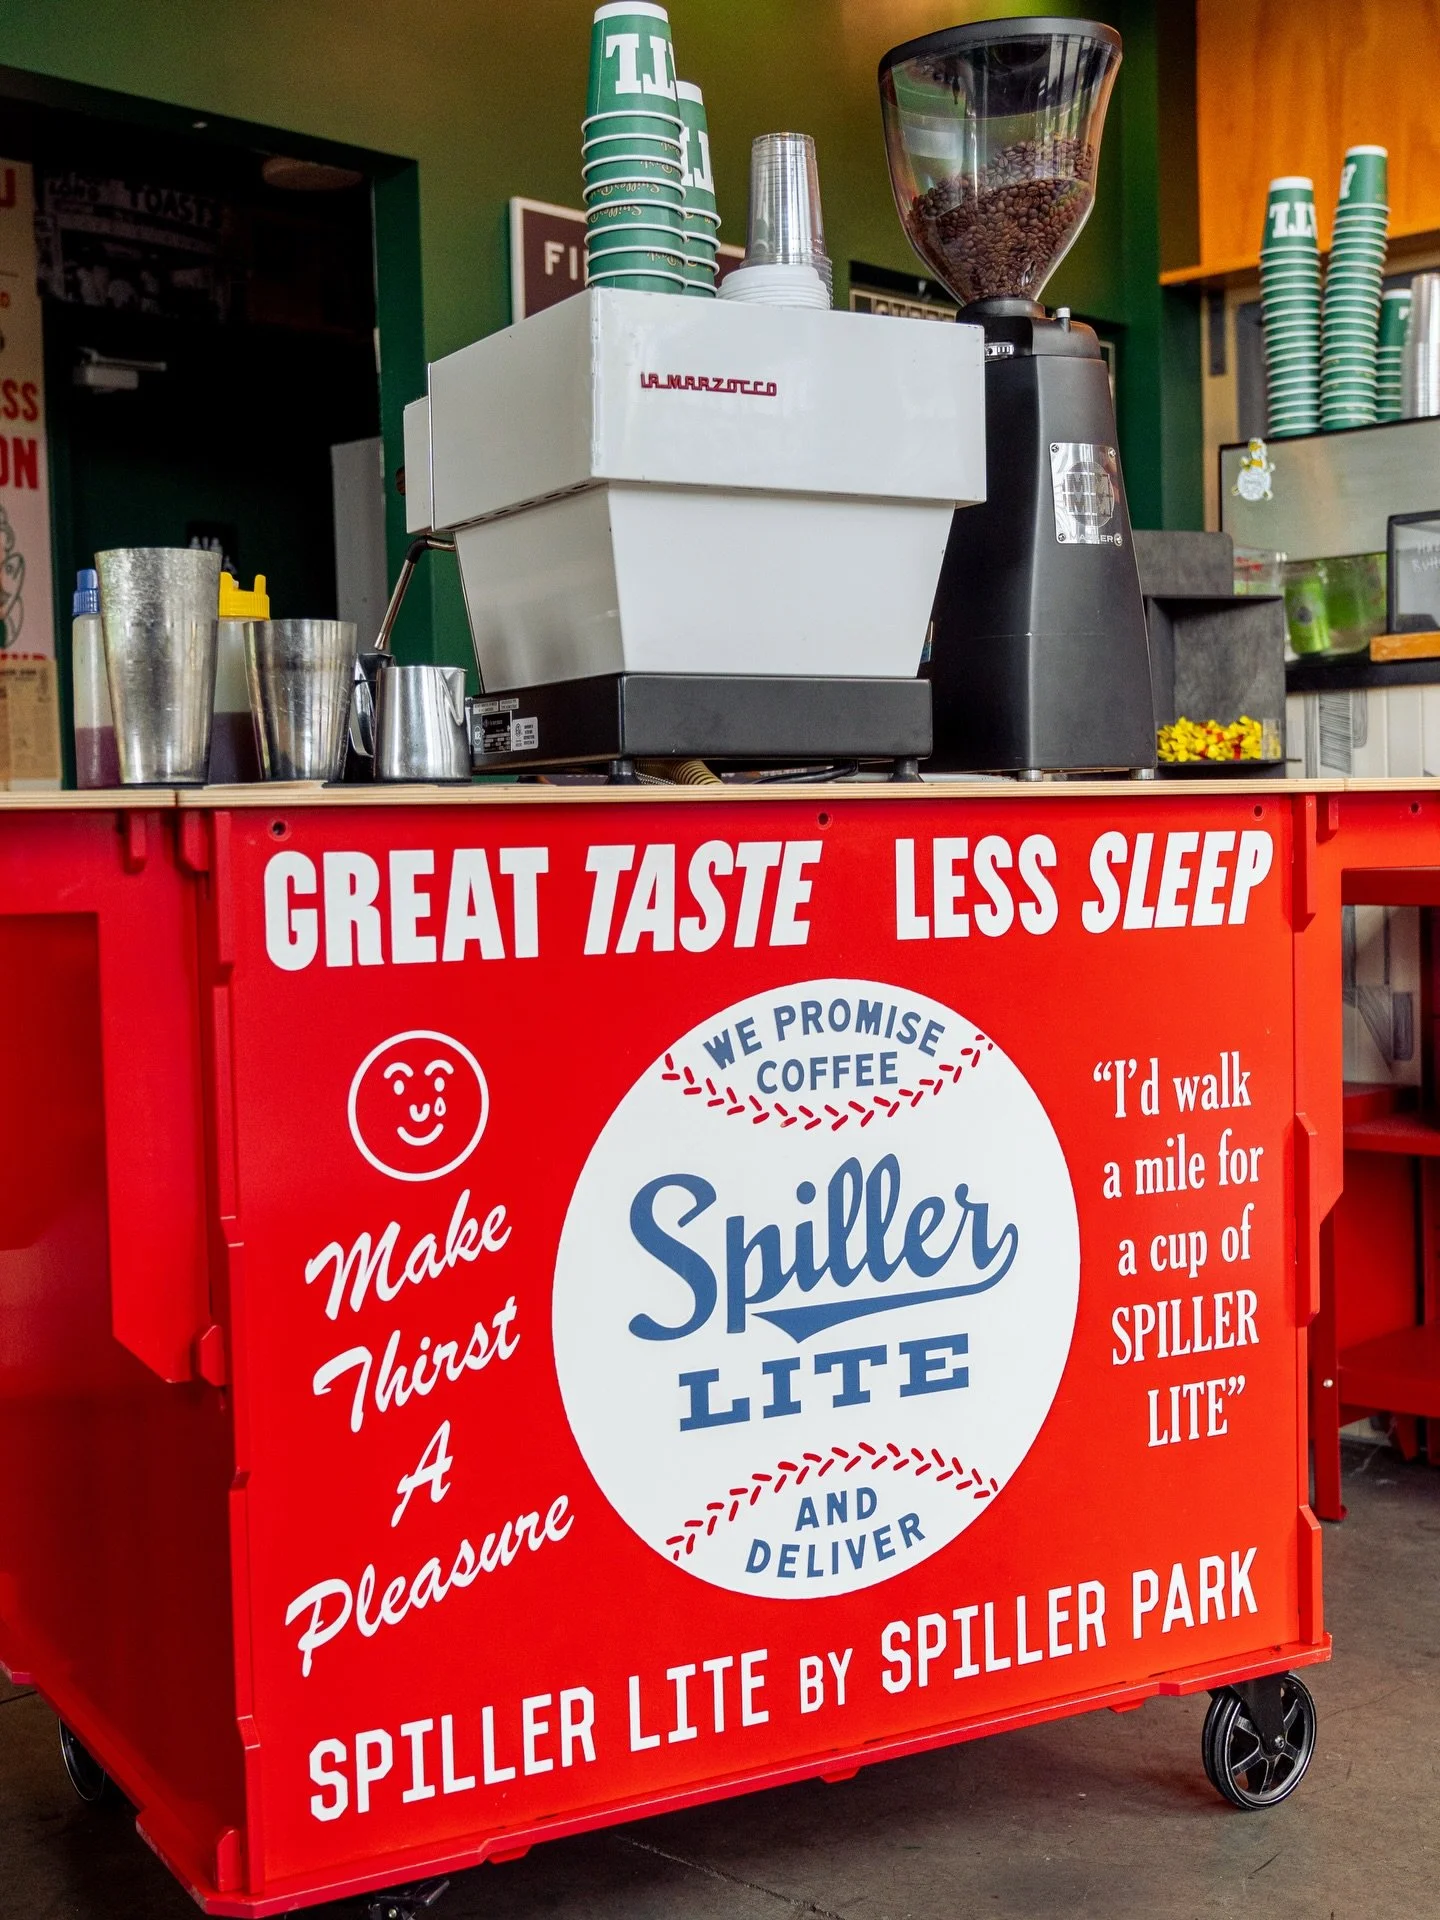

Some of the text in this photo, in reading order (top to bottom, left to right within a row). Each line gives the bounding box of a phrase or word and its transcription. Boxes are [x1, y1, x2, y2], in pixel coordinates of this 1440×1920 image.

[605, 33, 676, 101] TL
[544, 240, 590, 286] FI
[640, 371, 777, 397] LA MARZOCCO
[1070, 533, 1114, 544] MAER
[264, 830, 1274, 971] GREAT TASTE LESS SLEEP
[703, 998, 946, 1070] WE PROMISE
[756, 1051, 898, 1094] COFFEE
[1093, 1050, 1252, 1119] “I’d walk
[1102, 1127, 1265, 1200] a mile for
[304, 1188, 513, 1321] Make
[628, 1153, 1019, 1343] Spiller
[1117, 1202, 1255, 1279] a cup of
[312, 1295, 520, 1433] Thirst
[1111, 1289, 1260, 1366] SPILLER
[679, 1332, 970, 1432] LITE
[1146, 1375, 1246, 1448] LITE”
[391, 1419, 454, 1528] A
[794, 1486, 878, 1532] AND
[745, 1512, 926, 1578] DELIVER
[285, 1494, 575, 1678] Pleasure
[309, 1547, 1259, 1822] SPILLER LITE BY SPILLER PARK
